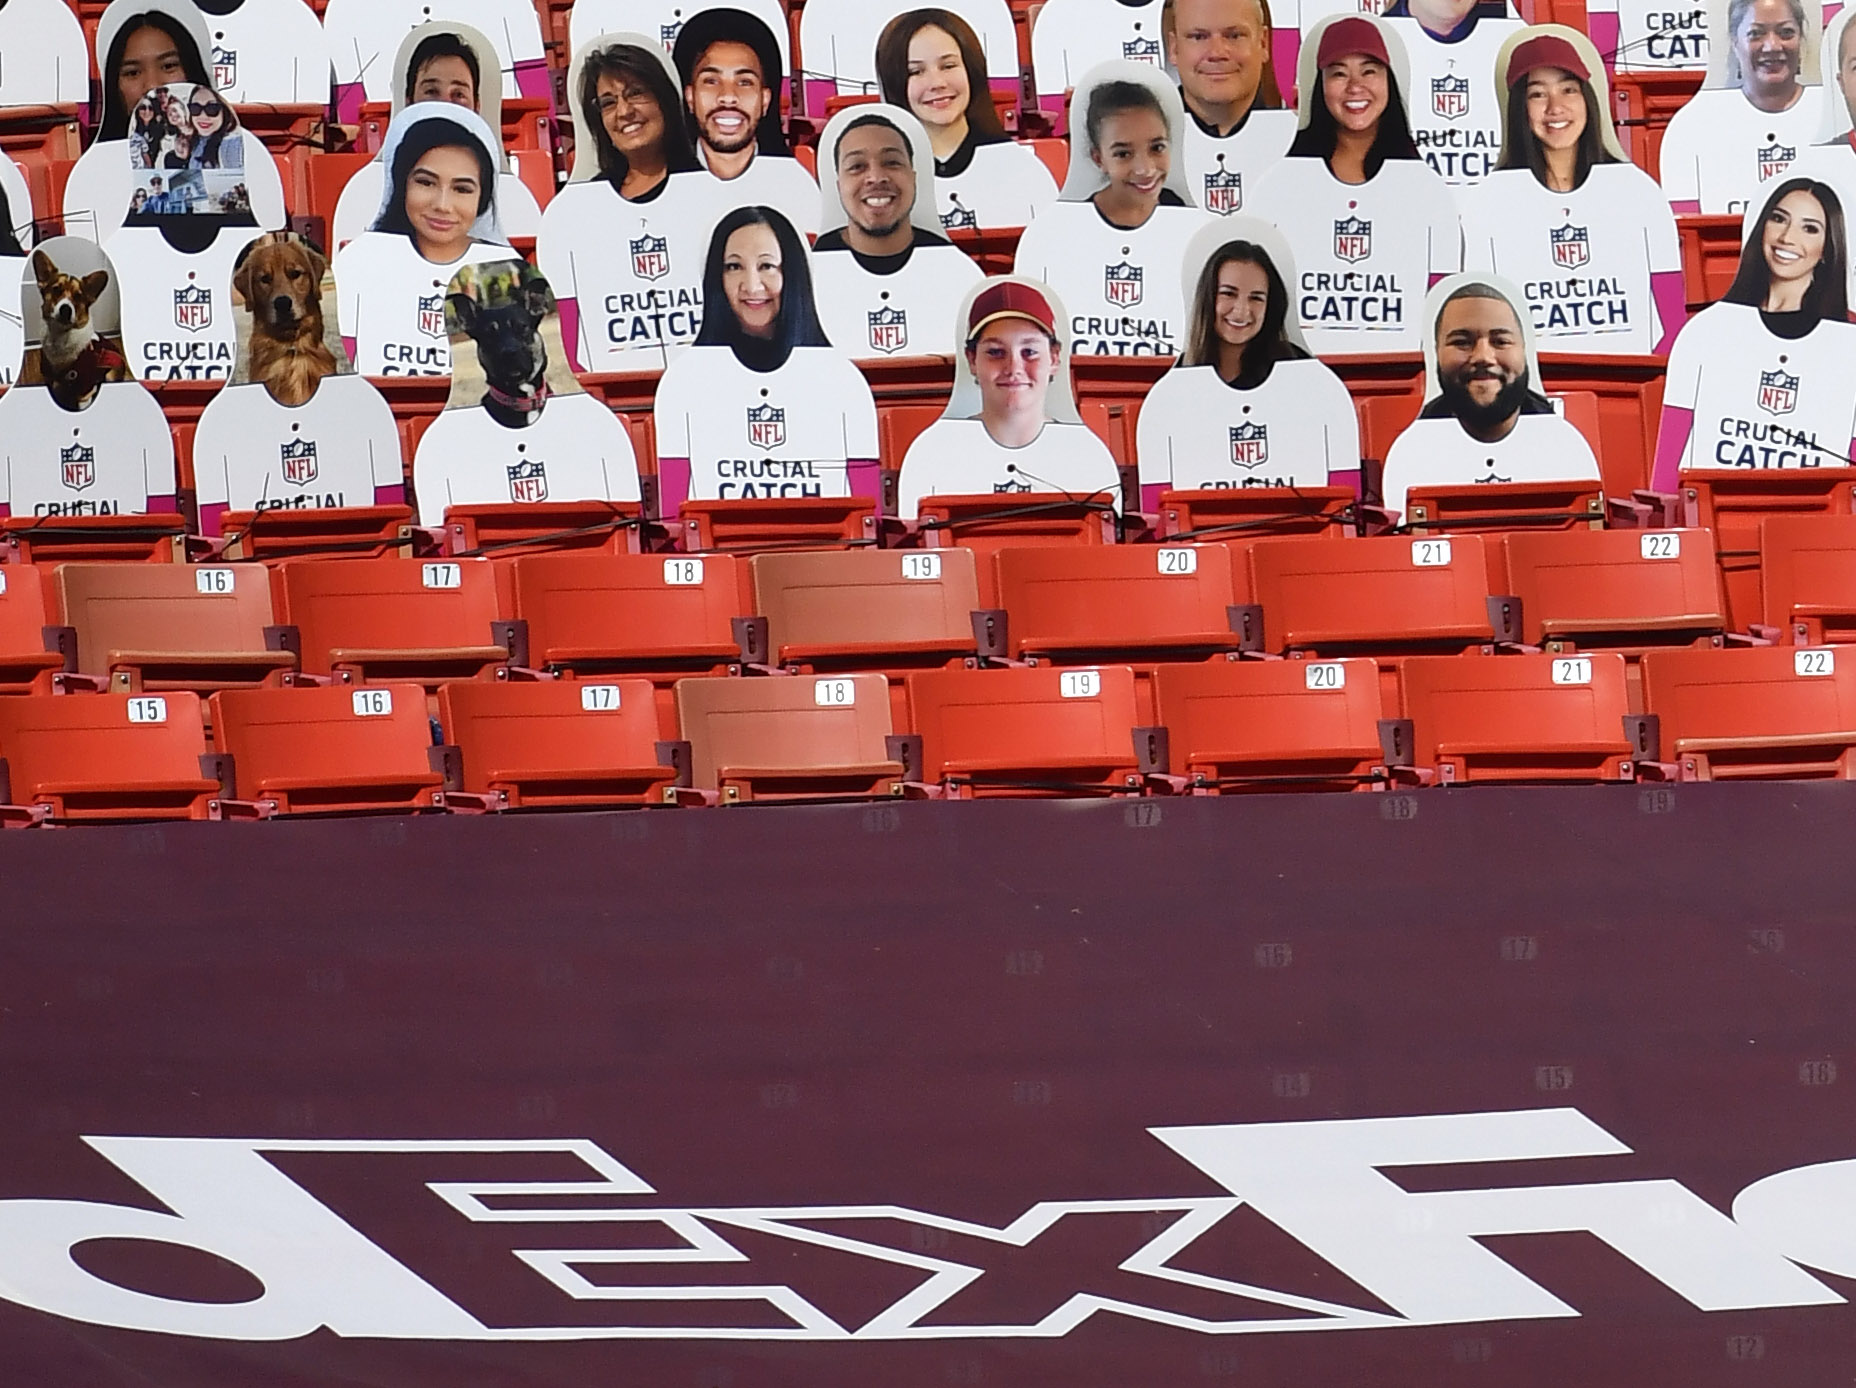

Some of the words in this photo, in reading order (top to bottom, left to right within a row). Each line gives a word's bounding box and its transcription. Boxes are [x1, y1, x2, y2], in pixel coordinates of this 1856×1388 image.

[1435, 93, 1465, 114] NFL
[1338, 236, 1367, 257] NFL
[1556, 242, 1586, 263] NFL
[636, 253, 666, 274] NFL
[1109, 280, 1139, 302] NFL
[1300, 271, 1403, 296] CRUCIAL
[1524, 276, 1626, 302] CRUCIAL
[178, 304, 208, 325] NFL
[1300, 295, 1403, 323] CATCH
[873, 325, 904, 346] NFL
[1071, 315, 1175, 340] CRUCIAL
[1761, 387, 1791, 409] NFL
[752, 422, 781, 443] NFL
[1718, 416, 1820, 454] CRUCIAL
[1234, 440, 1265, 463] NFL
[65, 462, 95, 484] NFL
[285, 457, 315, 480] NFL
[716, 458, 821, 481] CRUCIAL
[513, 479, 543, 500] NFL
[1421, 543, 1442, 563] 21
[1649, 536, 1671, 557] 22
[673, 562, 694, 582] 18
[910, 556, 932, 577] 19
[1165, 552, 1188, 571] 20
[204, 572, 226, 590] 16
[430, 566, 451, 585] 17
[1562, 662, 1582, 681] 21
[1803, 653, 1826, 673] 22
[1312, 666, 1336, 687] 20
[361, 693, 383, 712] 16
[590, 688, 611, 708] 17
[824, 682, 845, 703] 18
[135, 700, 158, 720] 15
